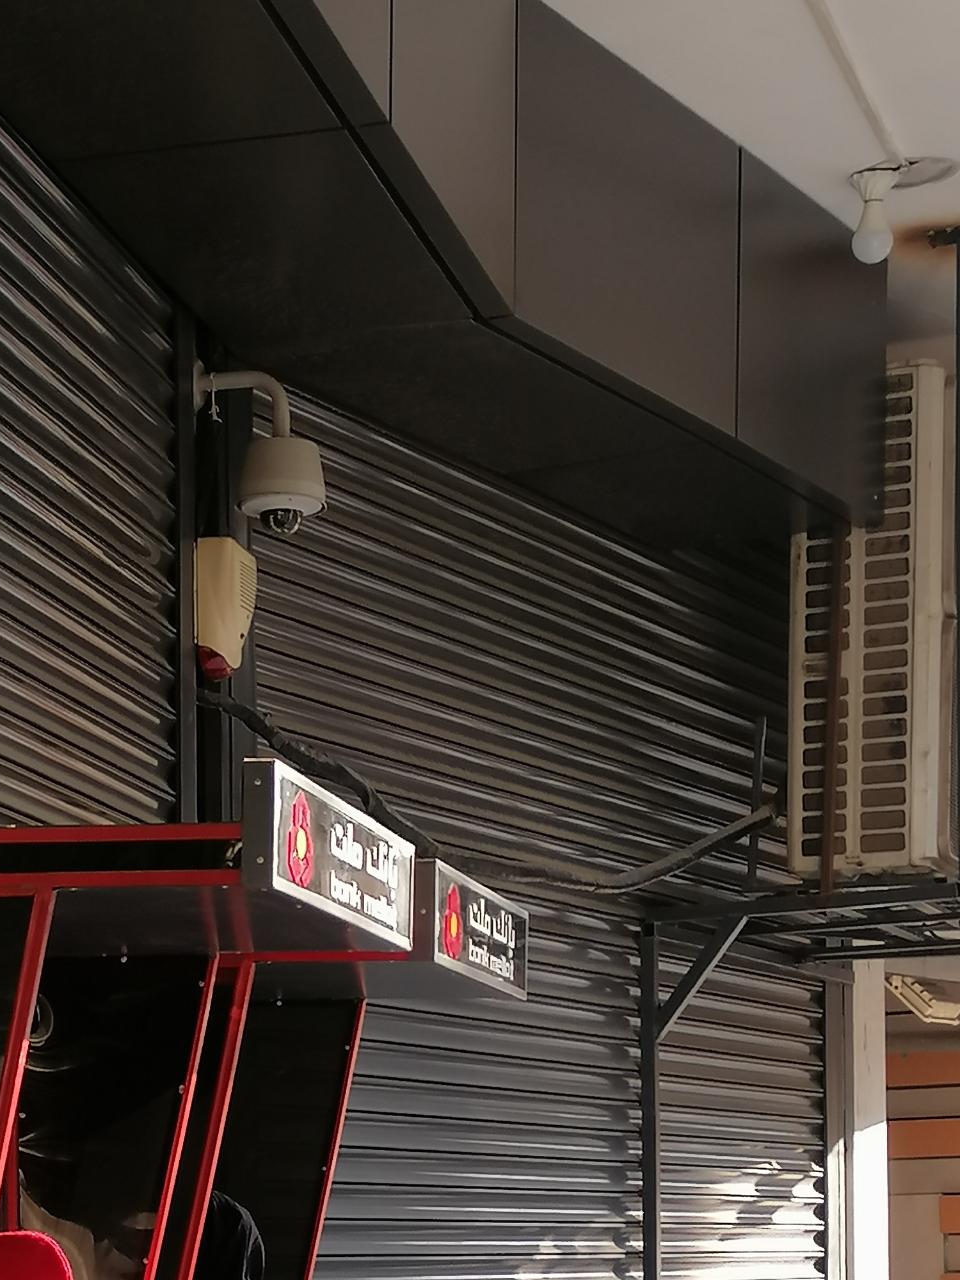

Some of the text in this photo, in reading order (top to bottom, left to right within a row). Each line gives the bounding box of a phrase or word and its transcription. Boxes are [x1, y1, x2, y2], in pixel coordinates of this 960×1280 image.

[330, 822, 364, 871] ملت
[330, 869, 362, 910] bank
[468, 898, 491, 937] ملت
[468, 936, 490, 969] bank
